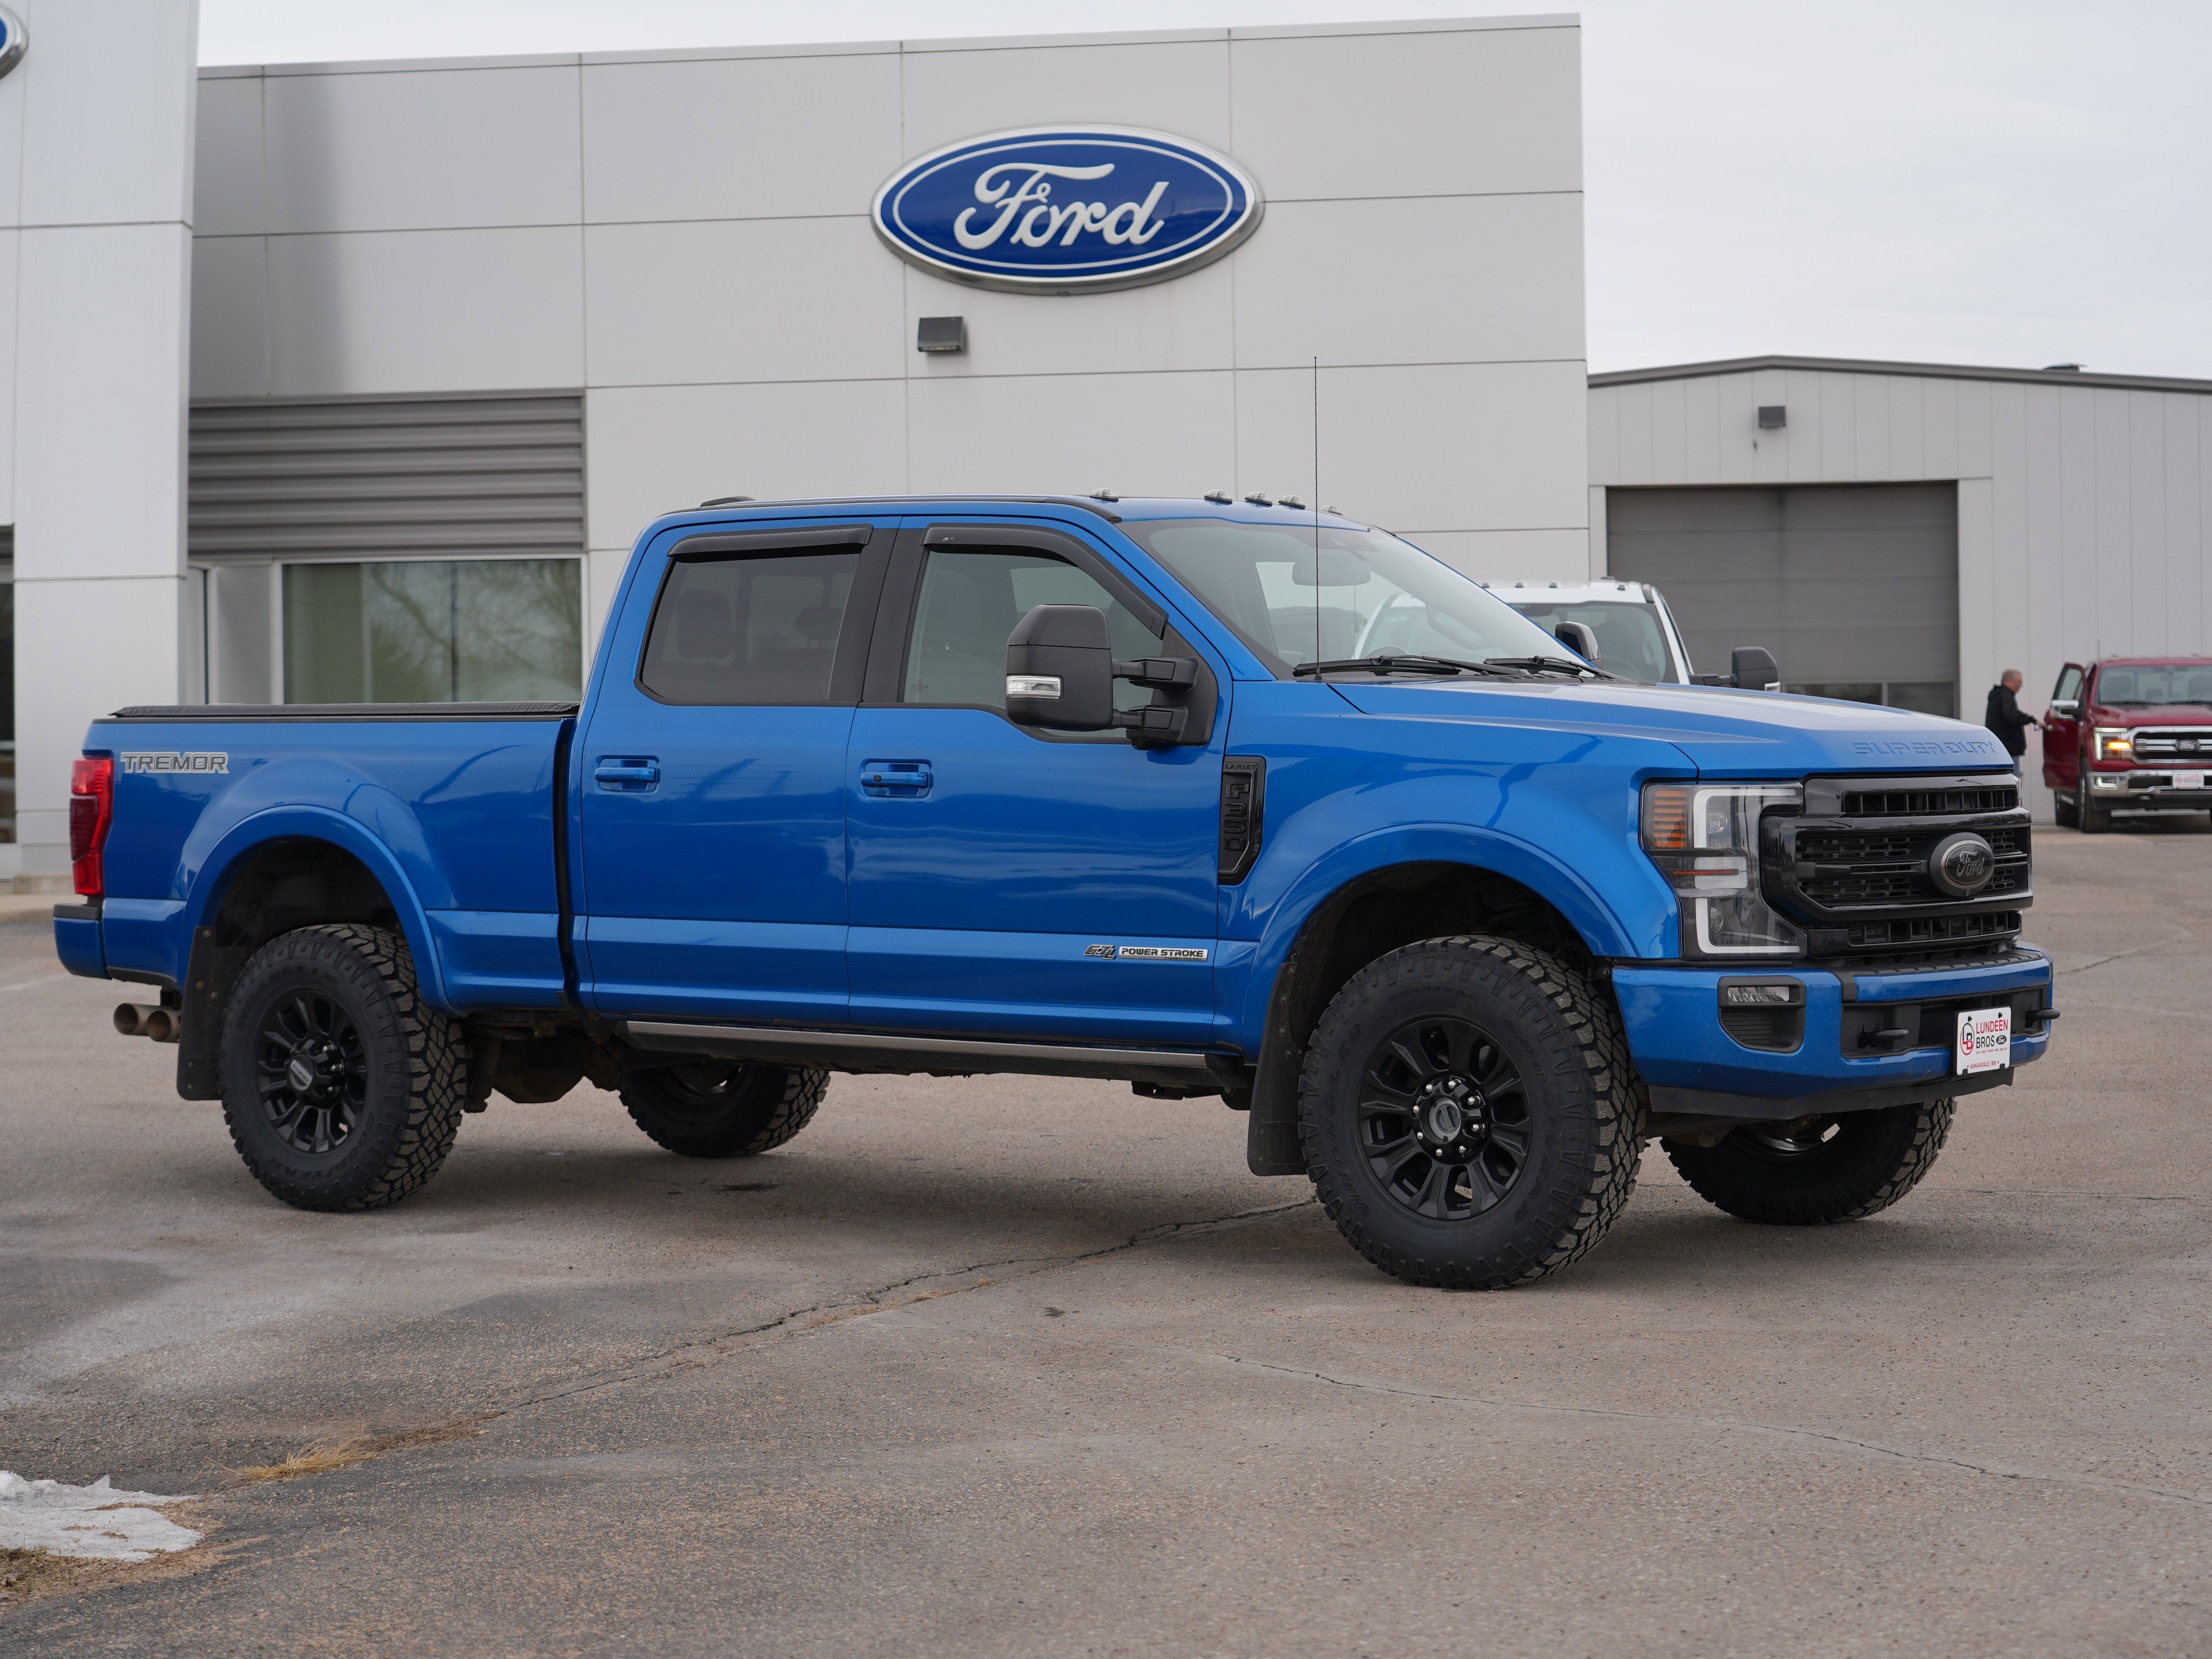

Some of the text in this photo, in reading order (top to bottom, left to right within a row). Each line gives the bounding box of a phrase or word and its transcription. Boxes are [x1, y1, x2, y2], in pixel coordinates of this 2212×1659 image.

[954, 163, 1169, 250] Ford
[1852, 741, 1996, 756] SUPER DUTY
[121, 752, 229, 773] TREMOR
[1224, 783, 1250, 851] F350
[1957, 851, 1986, 877] Ford
[1083, 944, 1204, 960] 6.7L POWER STROKE
[1976, 1019, 2008, 1034] LUNDEEN
[1976, 1035, 1995, 1049] BROS
[1325, 1023, 1371, 1218] WRANGLER
[1503, 1019, 1555, 1224] GOODYEAR
